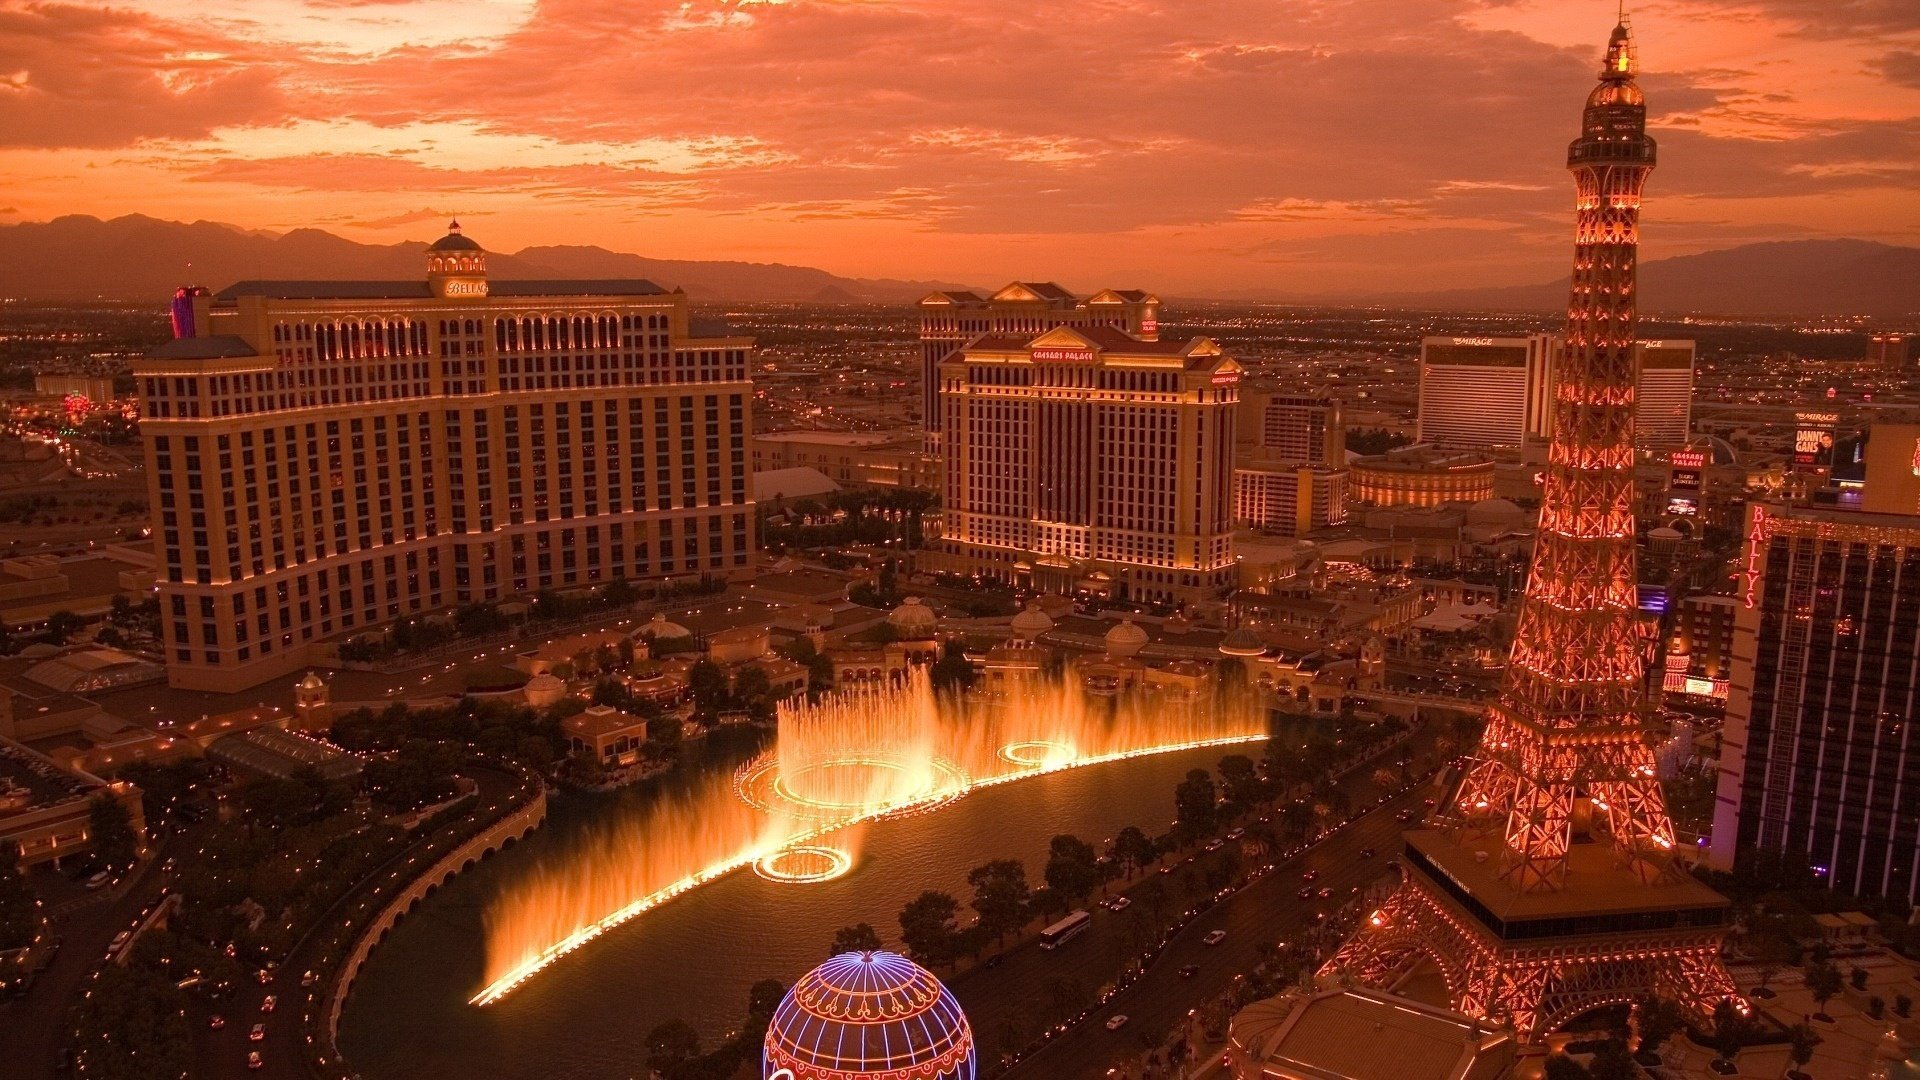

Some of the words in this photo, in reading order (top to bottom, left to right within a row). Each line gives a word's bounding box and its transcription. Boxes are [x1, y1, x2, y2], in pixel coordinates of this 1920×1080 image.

[1457, 337, 1493, 346] MIRAGE
[1033, 351, 1063, 360] CAESARS
[1065, 352, 1093, 361] PALACE
[1800, 413, 1839, 422] MIRAGE
[1796, 430, 1825, 442] DANNY
[1796, 441, 1819, 453] GANS
[1672, 452, 1704, 461] CAESARS
[1673, 459, 1703, 467] PALACE
